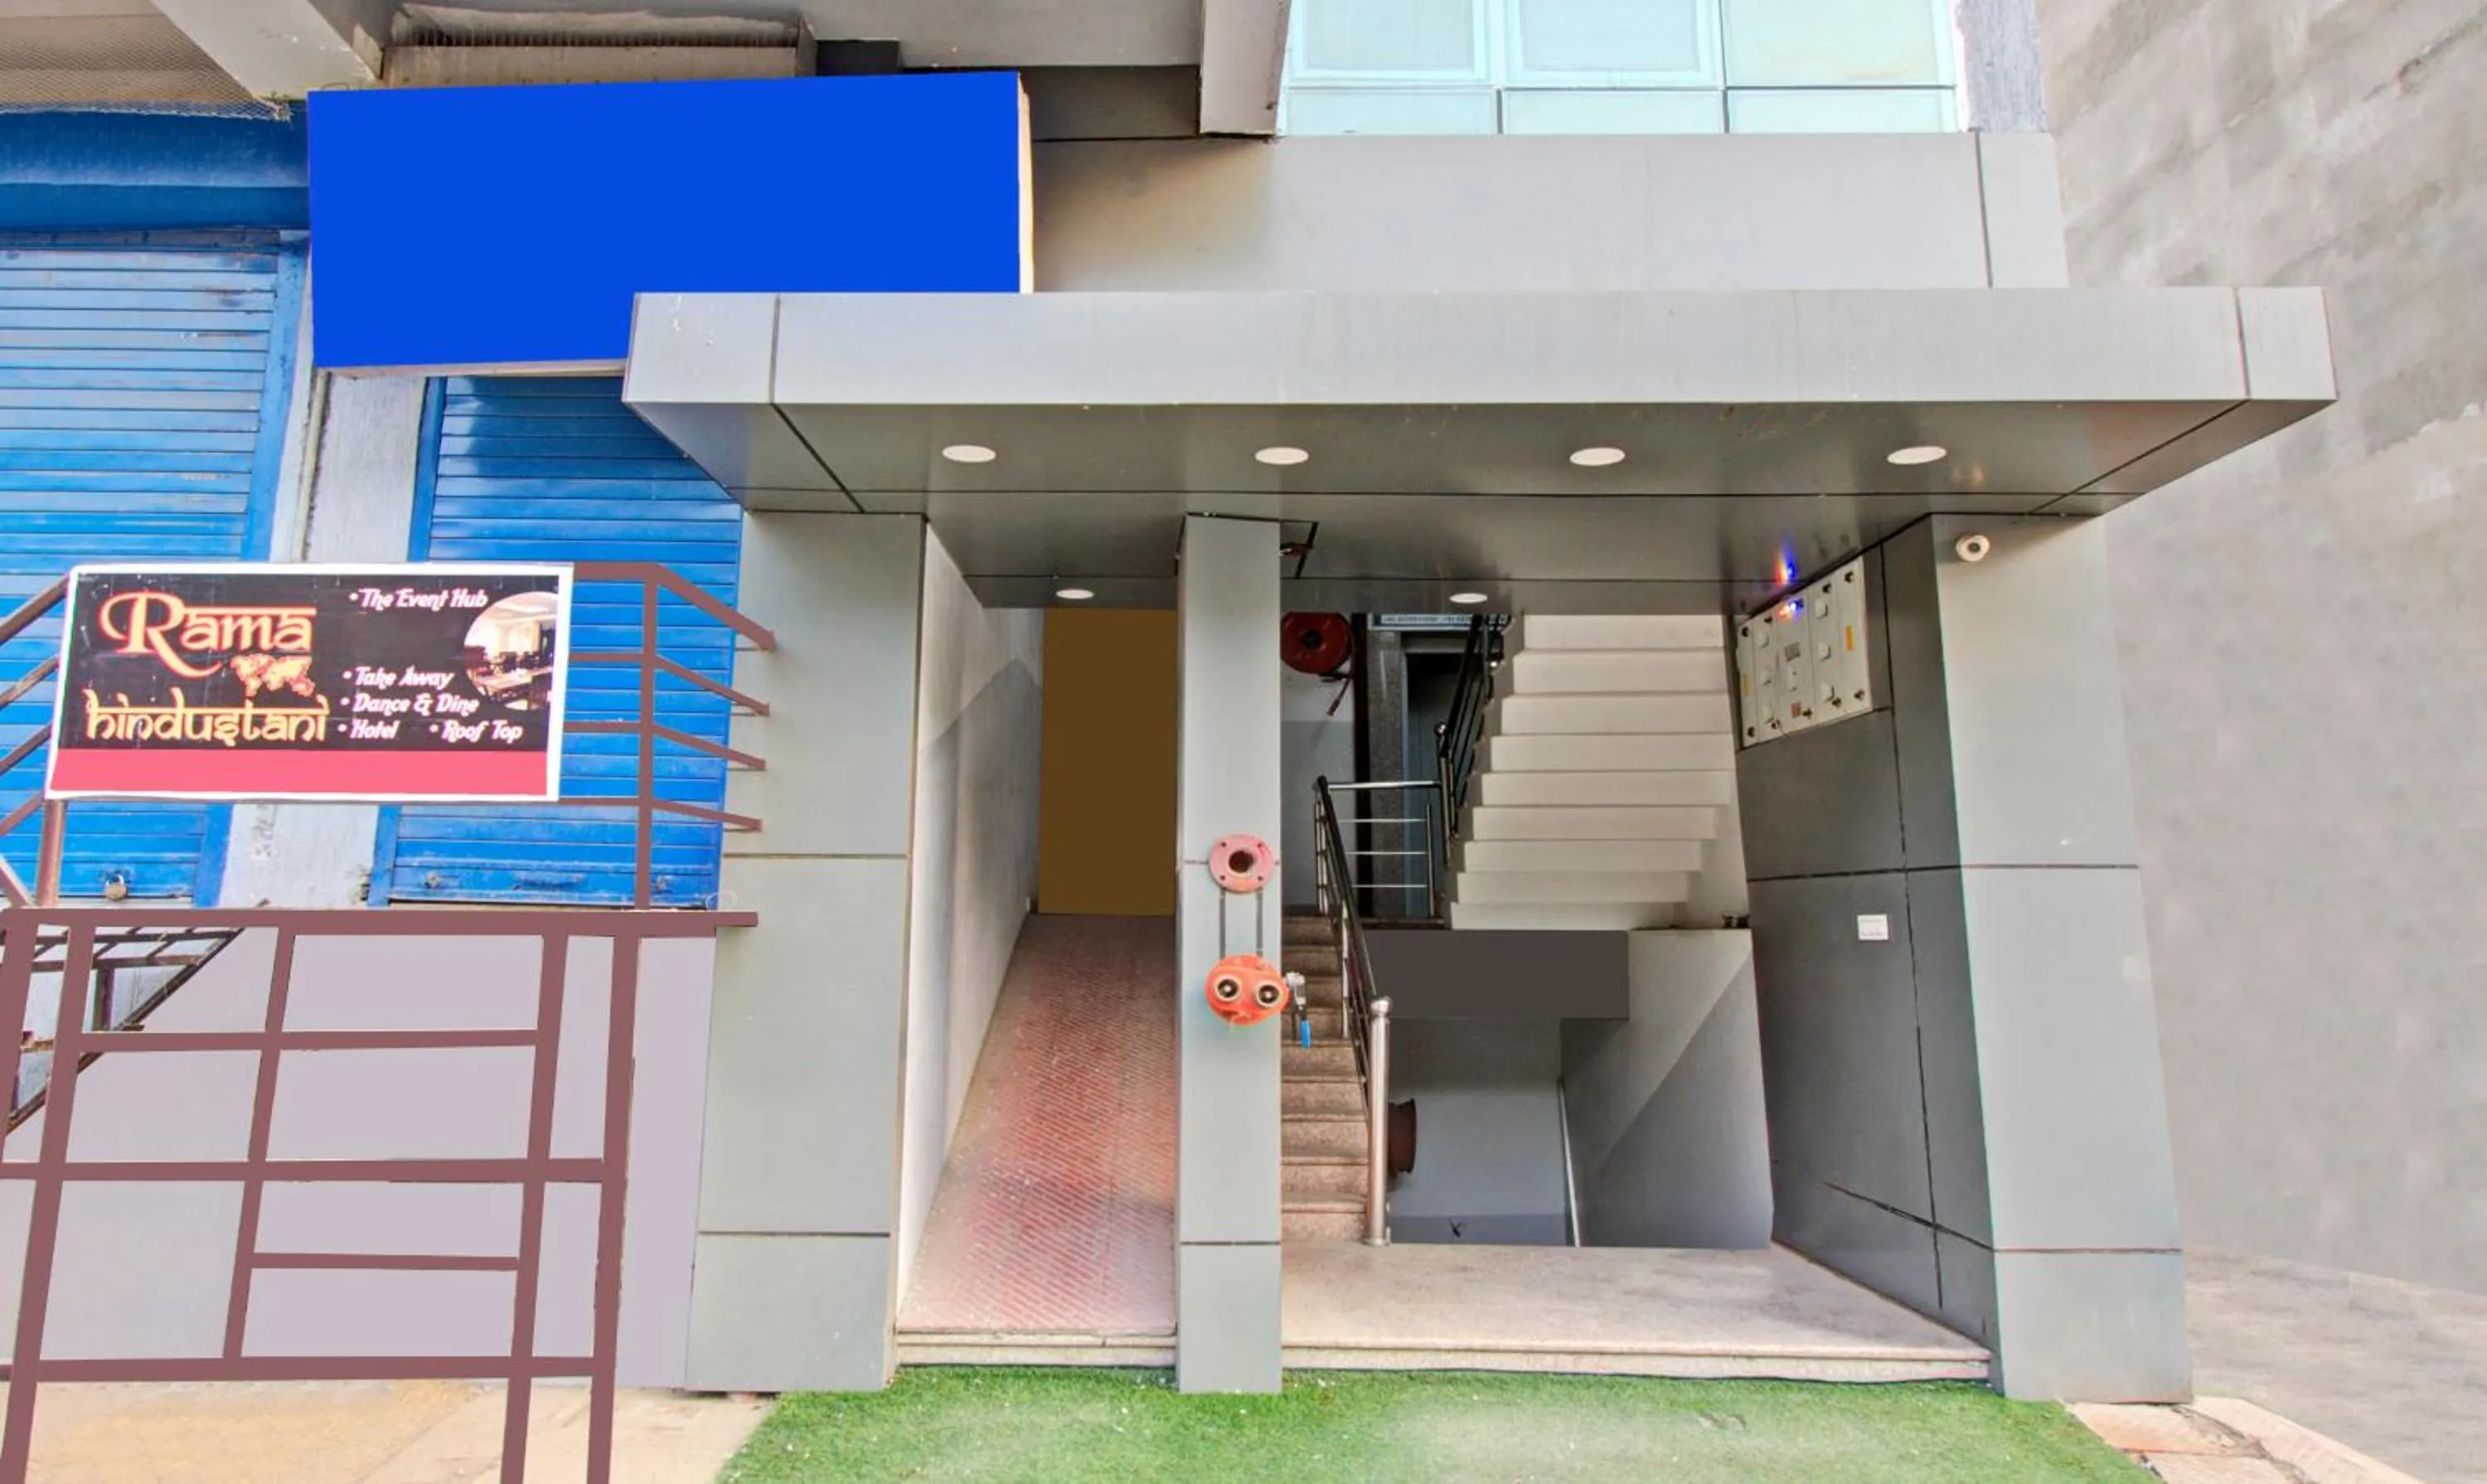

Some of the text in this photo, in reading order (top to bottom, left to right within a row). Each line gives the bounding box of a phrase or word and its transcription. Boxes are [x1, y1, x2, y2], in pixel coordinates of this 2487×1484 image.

[358, 588, 488, 612] The Event Hub
[96, 589, 317, 679] Rama
[355, 665, 455, 691] Take Away
[81, 686, 330, 746] hindustani
[352, 693, 480, 717] Dance & Dine
[349, 719, 400, 739] Hotel
[441, 720, 524, 744] Roof Top
